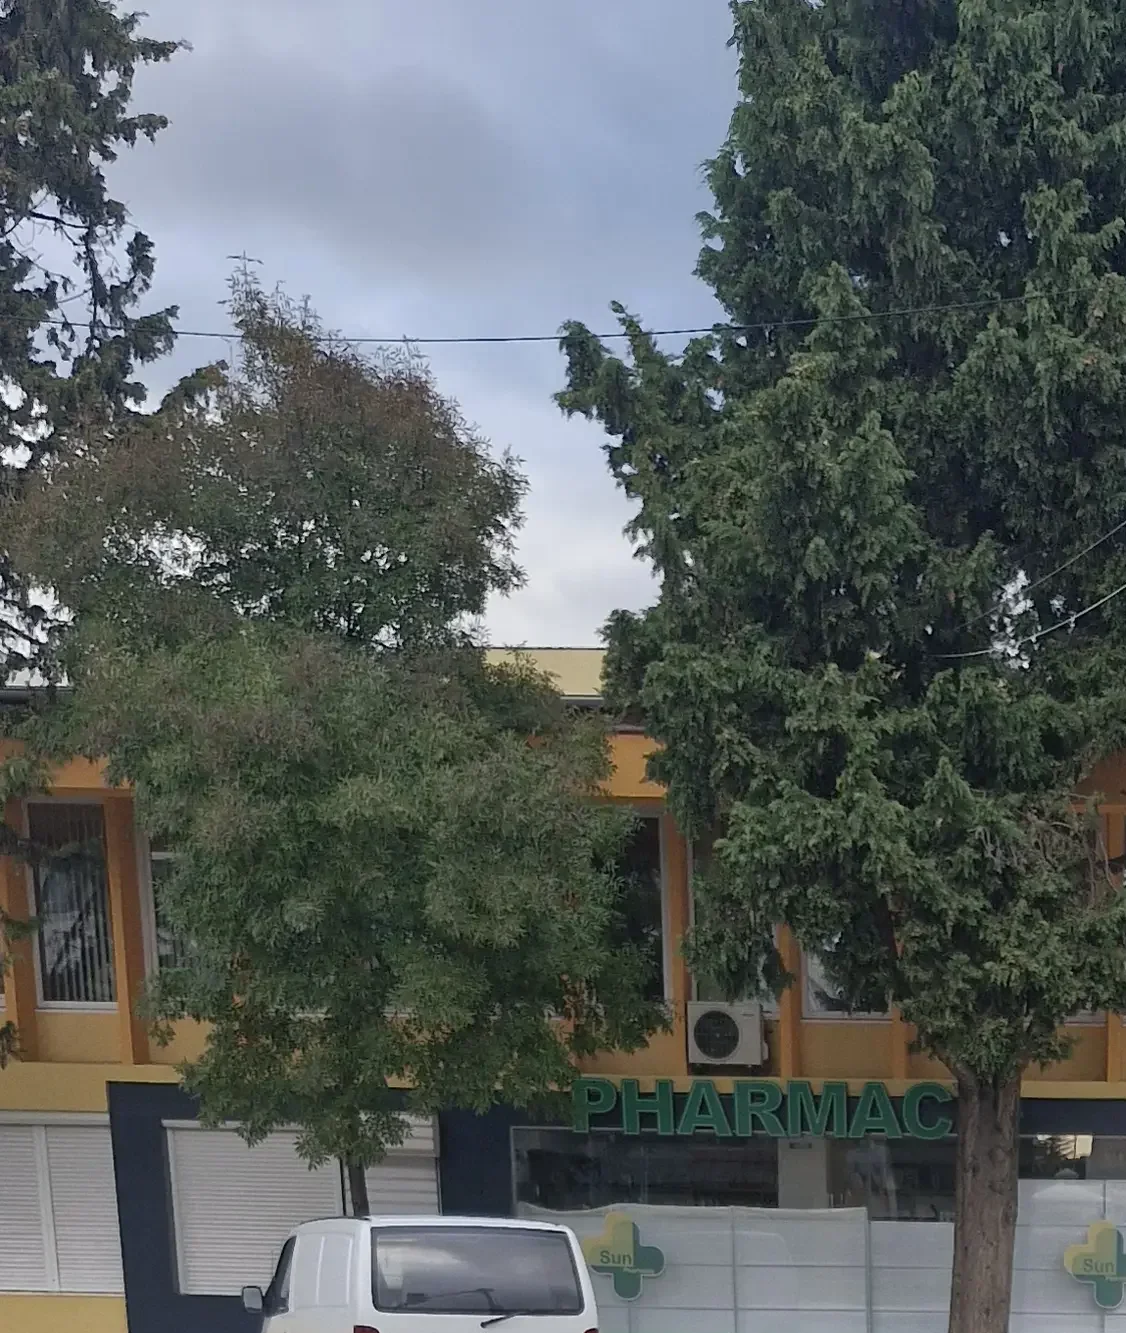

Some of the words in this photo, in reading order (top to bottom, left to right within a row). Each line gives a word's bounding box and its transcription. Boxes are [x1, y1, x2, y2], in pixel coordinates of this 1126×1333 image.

[570, 1078, 954, 1140] PHARMAC
[600, 1249, 633, 1265] Sun
[1083, 1258, 1116, 1273] Sun
